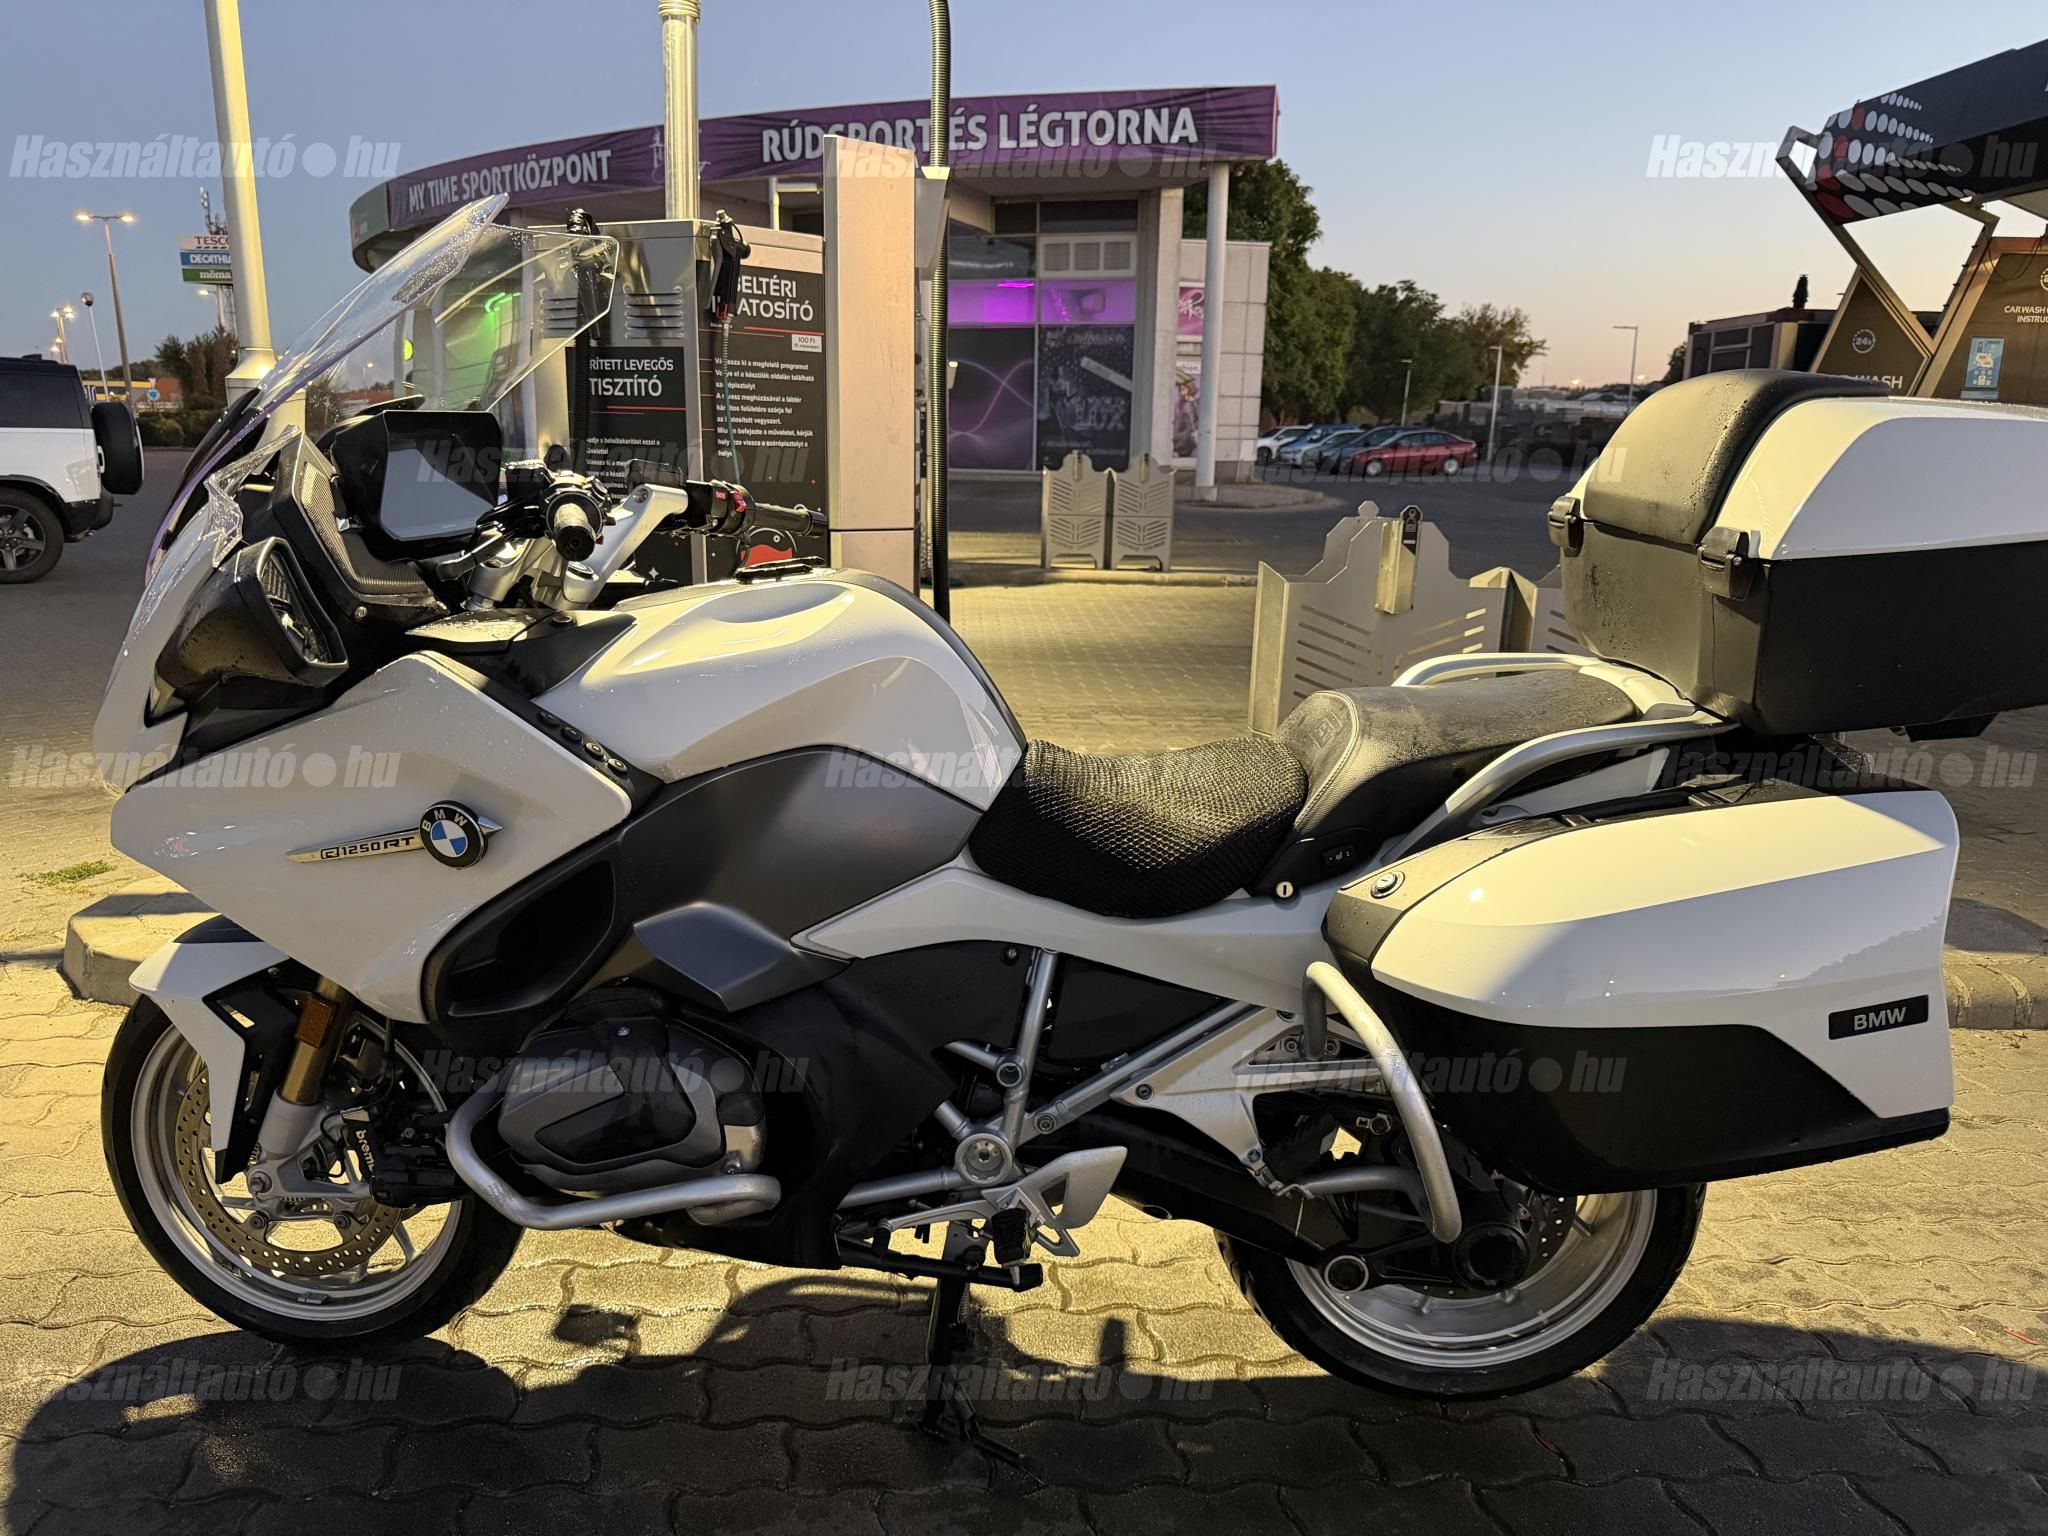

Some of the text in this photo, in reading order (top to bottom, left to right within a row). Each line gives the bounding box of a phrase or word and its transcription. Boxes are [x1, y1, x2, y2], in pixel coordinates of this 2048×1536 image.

[949, 106, 988, 152] ÉS
[999, 104, 1199, 150] LÉGTORNA
[408, 183, 426, 214] MY
[427, 172, 459, 208] TIME
[460, 149, 612, 201] SPORTKÖZPONT
[199, 269, 232, 279] möma
[738, 274, 797, 298] ELTÉRI
[798, 336, 809, 344] 100
[624, 356, 674, 371] LEVEGŐS
[588, 373, 663, 397] TISZTÍTÓ
[1853, 1006, 1907, 1031] BMW
